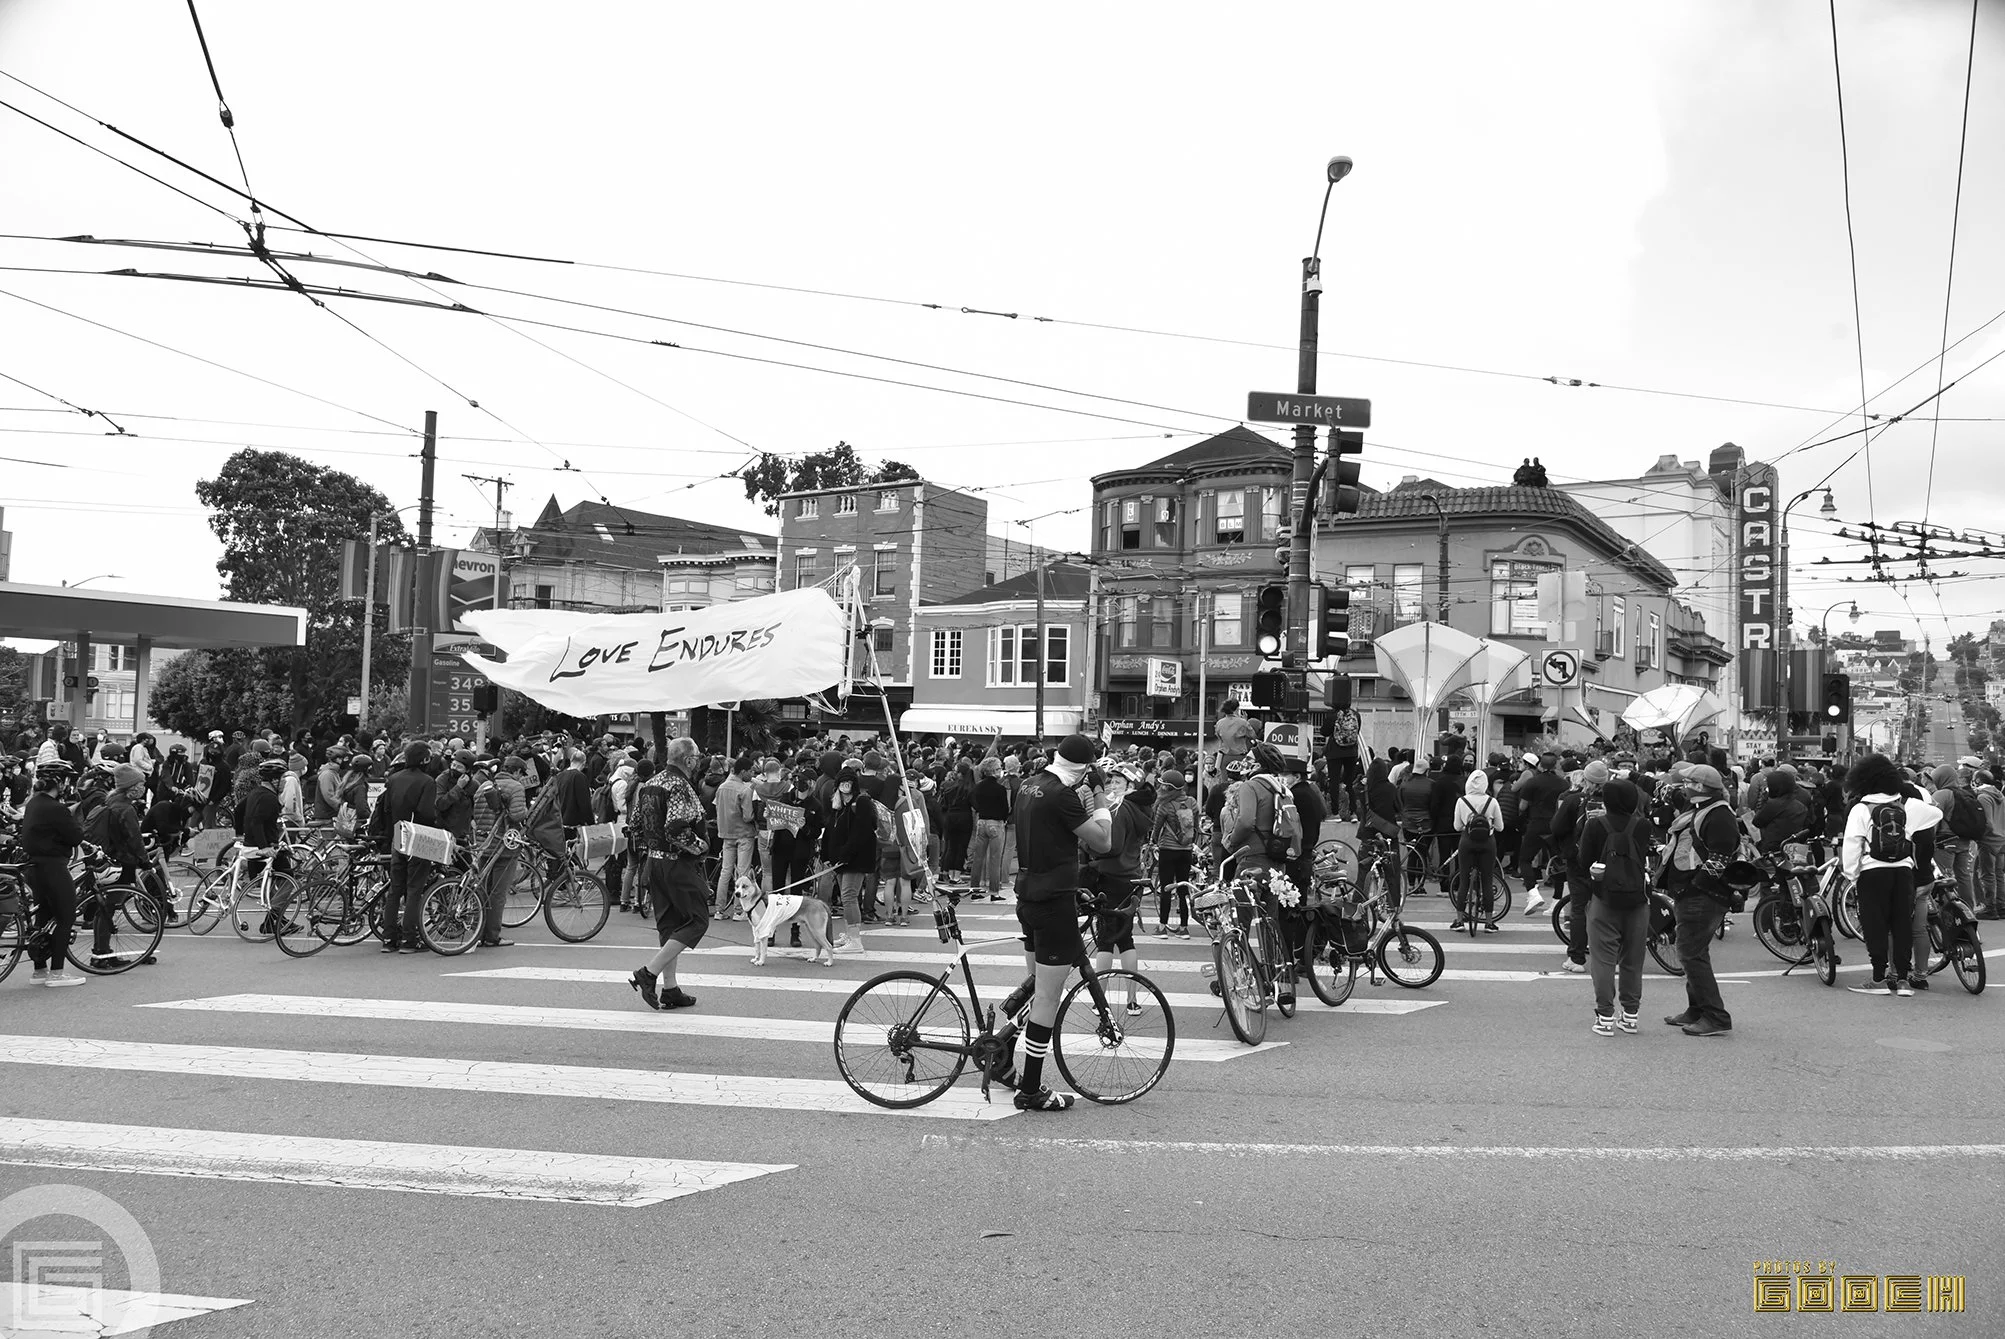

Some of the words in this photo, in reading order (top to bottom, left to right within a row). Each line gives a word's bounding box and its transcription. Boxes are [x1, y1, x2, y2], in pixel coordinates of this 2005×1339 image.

[1276, 400, 1342, 419] Market
[454, 559, 496, 573] evron
[1743, 486, 1771, 649] CASTR
[434, 658, 460, 667] Gasoline
[549, 635, 639, 683] LOVE
[450, 698, 472, 712] 35
[1109, 719, 1134, 730] Orphan
[1138, 719, 1166, 732] Andy's
[1271, 733, 1284, 742] DO
[1287, 734, 1299, 743] NO
[768, 803, 799, 817] WHITE
